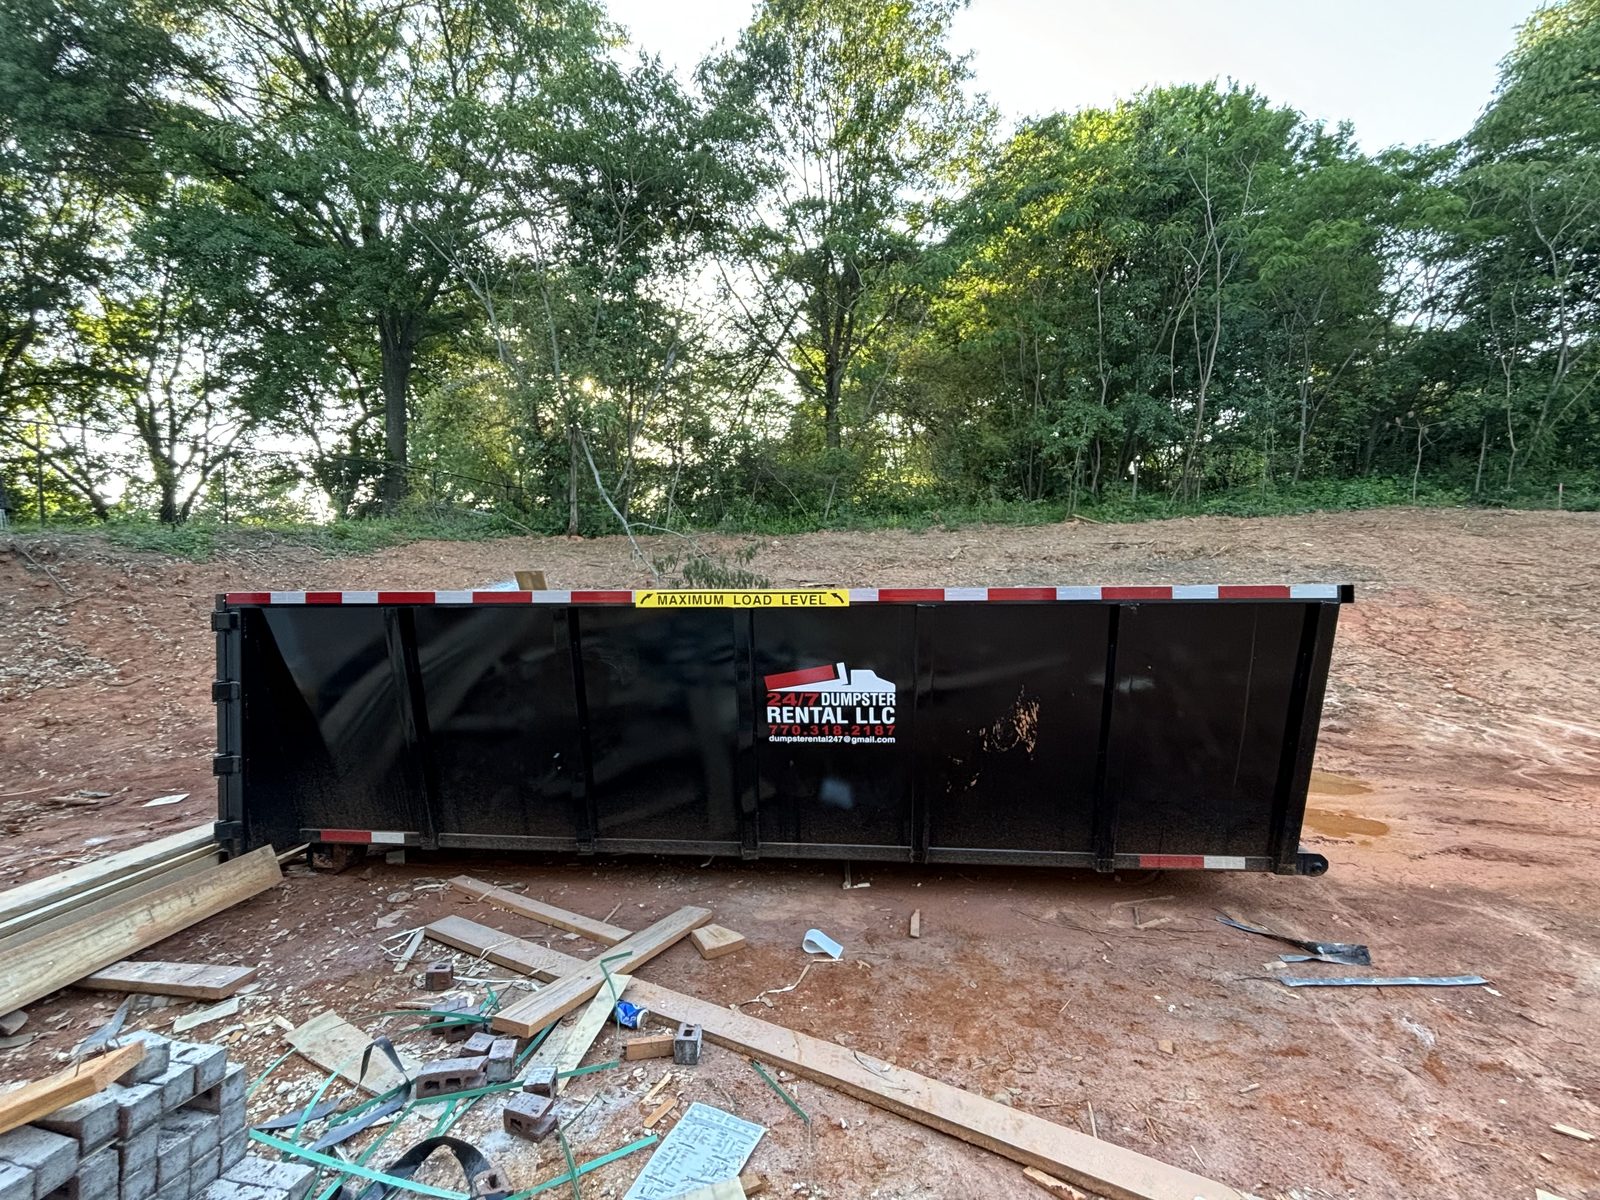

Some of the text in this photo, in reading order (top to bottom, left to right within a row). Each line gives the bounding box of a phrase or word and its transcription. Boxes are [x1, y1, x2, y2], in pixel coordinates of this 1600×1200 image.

[657, 594, 827, 606] MAXIMUM LOAD LEVEL
[766, 692, 897, 706] 24/7 DUMPSTER
[767, 706, 896, 724] RENTAL LLC
[768, 725, 896, 735] 770.318.2187
[768, 735, 896, 744] dumpsterental247@gmail.com
